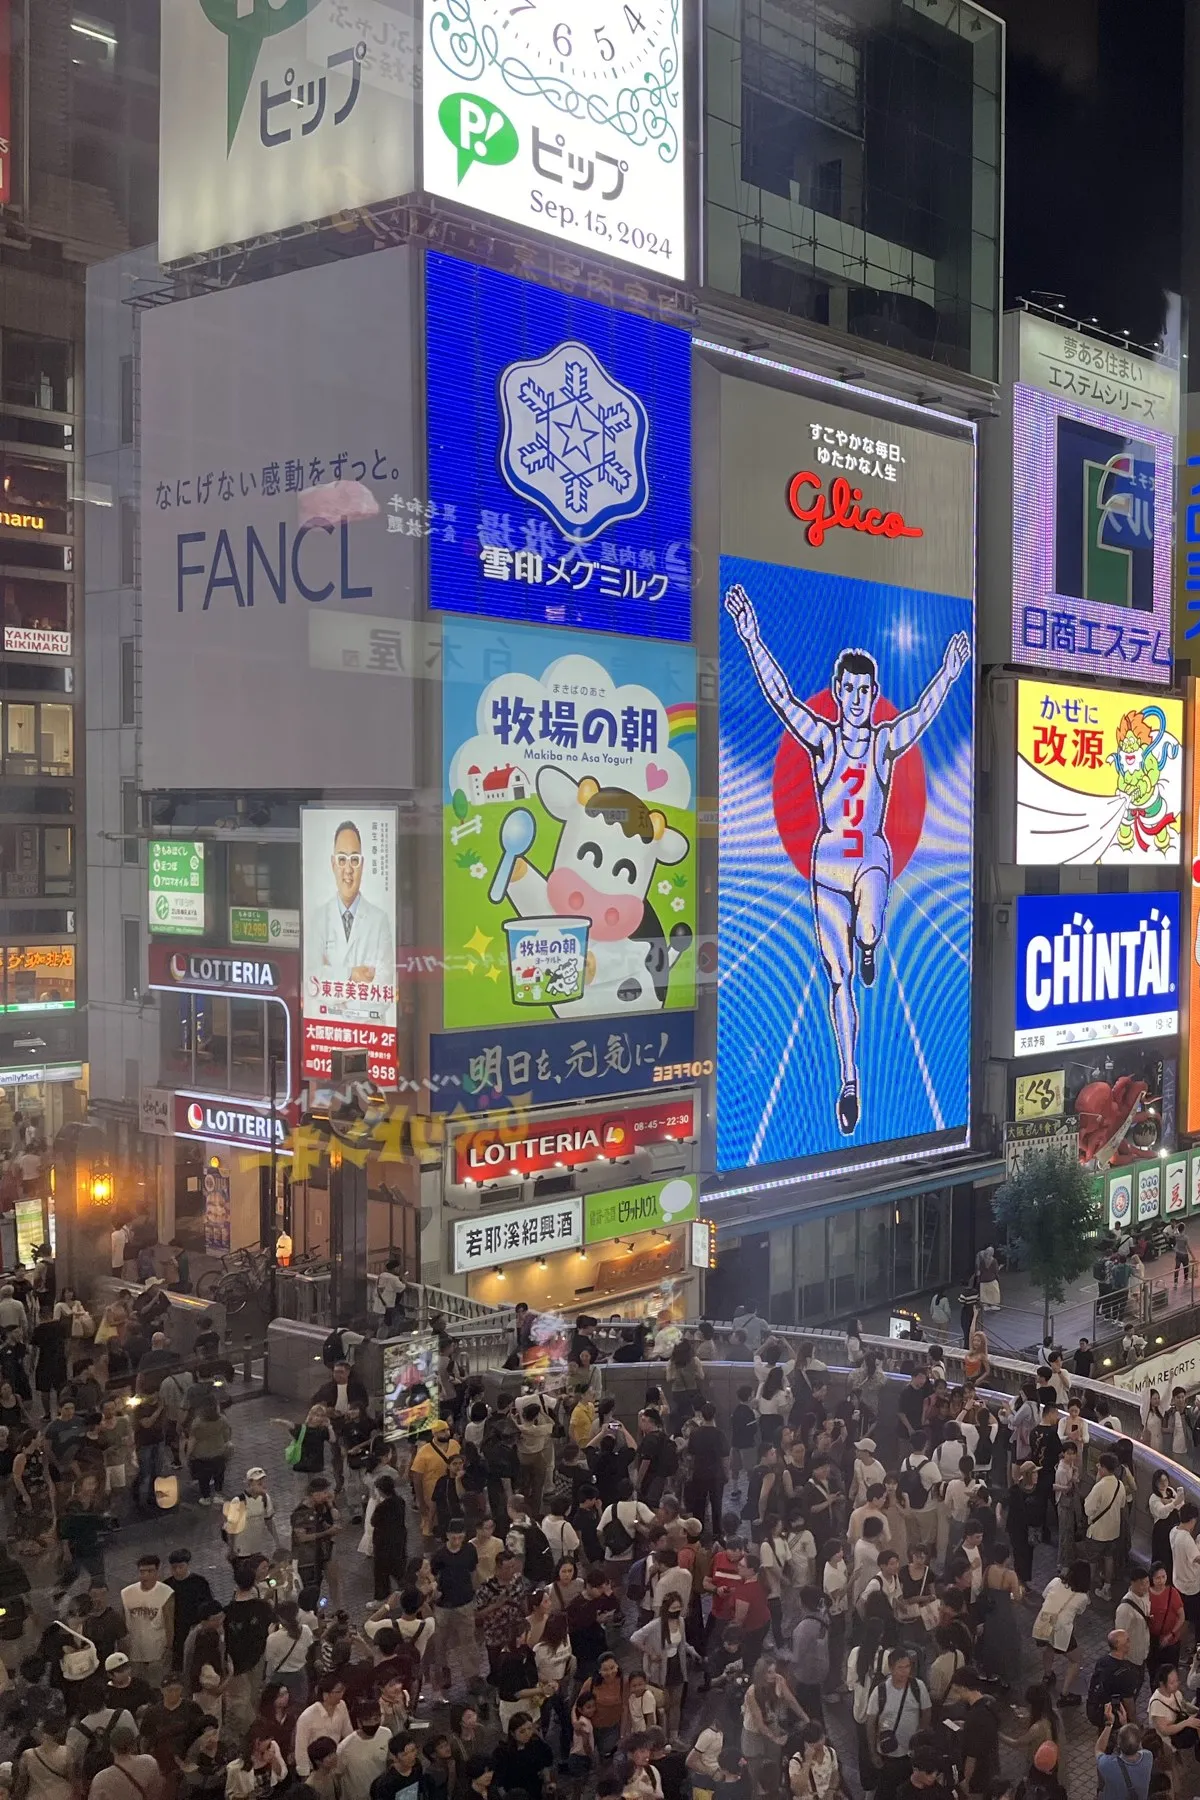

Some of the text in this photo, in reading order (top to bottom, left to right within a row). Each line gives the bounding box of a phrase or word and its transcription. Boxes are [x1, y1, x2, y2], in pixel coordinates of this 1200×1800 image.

[553, 23, 572, 56] 6
[594, 25, 615, 61] 5
[260, 41, 367, 147] ピップ
[531, 125, 629, 201] ピップ
[1063, 336, 1143, 383] 夢ある住まい
[1049, 366, 1155, 420] エステムシリーズ
[810, 423, 905, 463] すこやかな毎日、
[156, 449, 399, 510] なにげない感動をずっと。
[817, 446, 897, 481] ゆたかな人生
[788, 471, 923, 547] Glico
[177, 515, 373, 613] FANCL
[479, 546, 669, 601] 雪印メグミルク
[5, 640, 69, 653] RIKIMARU
[6, 630, 69, 644] YAKINIKU
[1023, 606, 1174, 666] 日商エステム
[552, 683, 606, 698] まきばのあさ
[1040, 694, 1099, 724] かぜに
[492, 696, 658, 754] 牧場の朝
[524, 748, 633, 766] Makiba no Asa Yogurt
[1033, 725, 1104, 770] 改源
[840, 763, 867, 858] グリコ
[520, 938, 576, 957] 牧場の朝
[535, 957, 561, 965] ヨーグルト
[1026, 908, 1171, 1012] CHINTAI
[191, 958, 273, 985] LOTTERIA
[321, 981, 394, 1003] 東京美容外科
[381, 1034, 396, 1046] 2F
[206, 1111, 284, 1142] LOTTERIA
[470, 1129, 599, 1168] LOTTERIA
[618, 1195, 658, 1224] ピタットハウス
